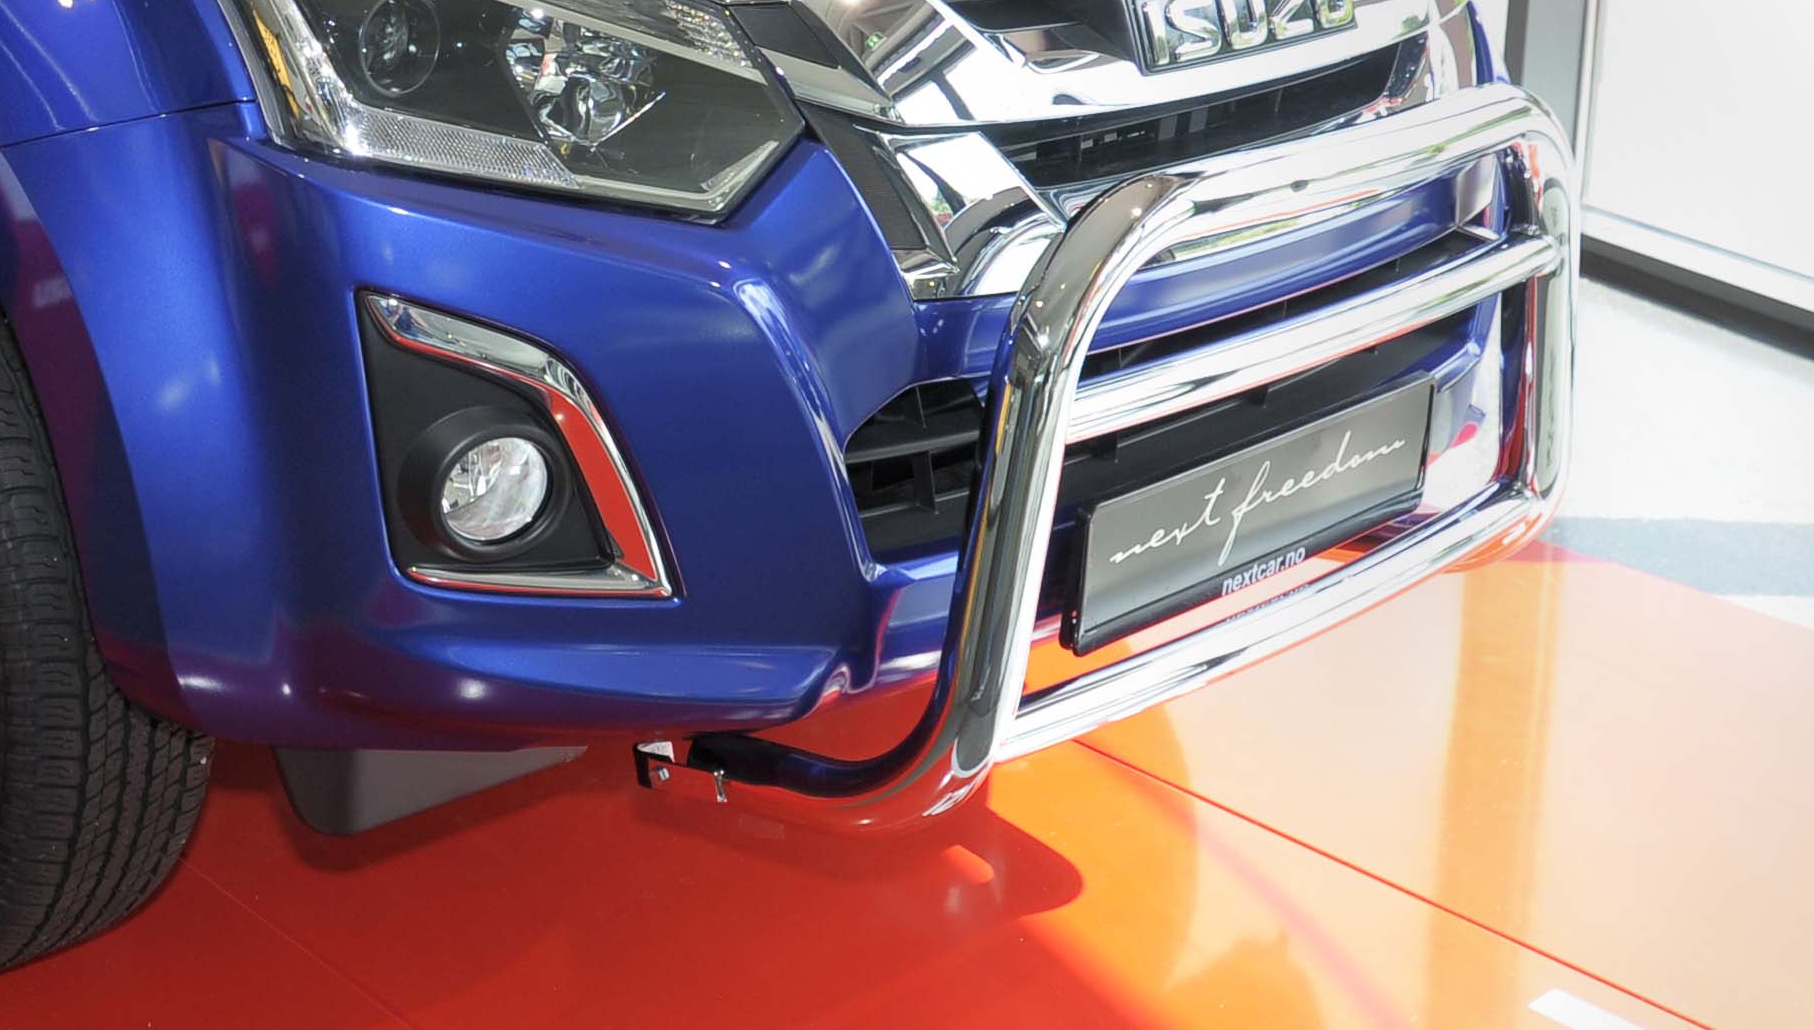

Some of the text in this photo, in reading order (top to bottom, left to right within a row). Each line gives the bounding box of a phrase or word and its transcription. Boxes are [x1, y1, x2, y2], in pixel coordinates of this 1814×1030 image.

[1109, 430, 1405, 566] next freedom
[1221, 545, 1306, 597] nextcar.no
